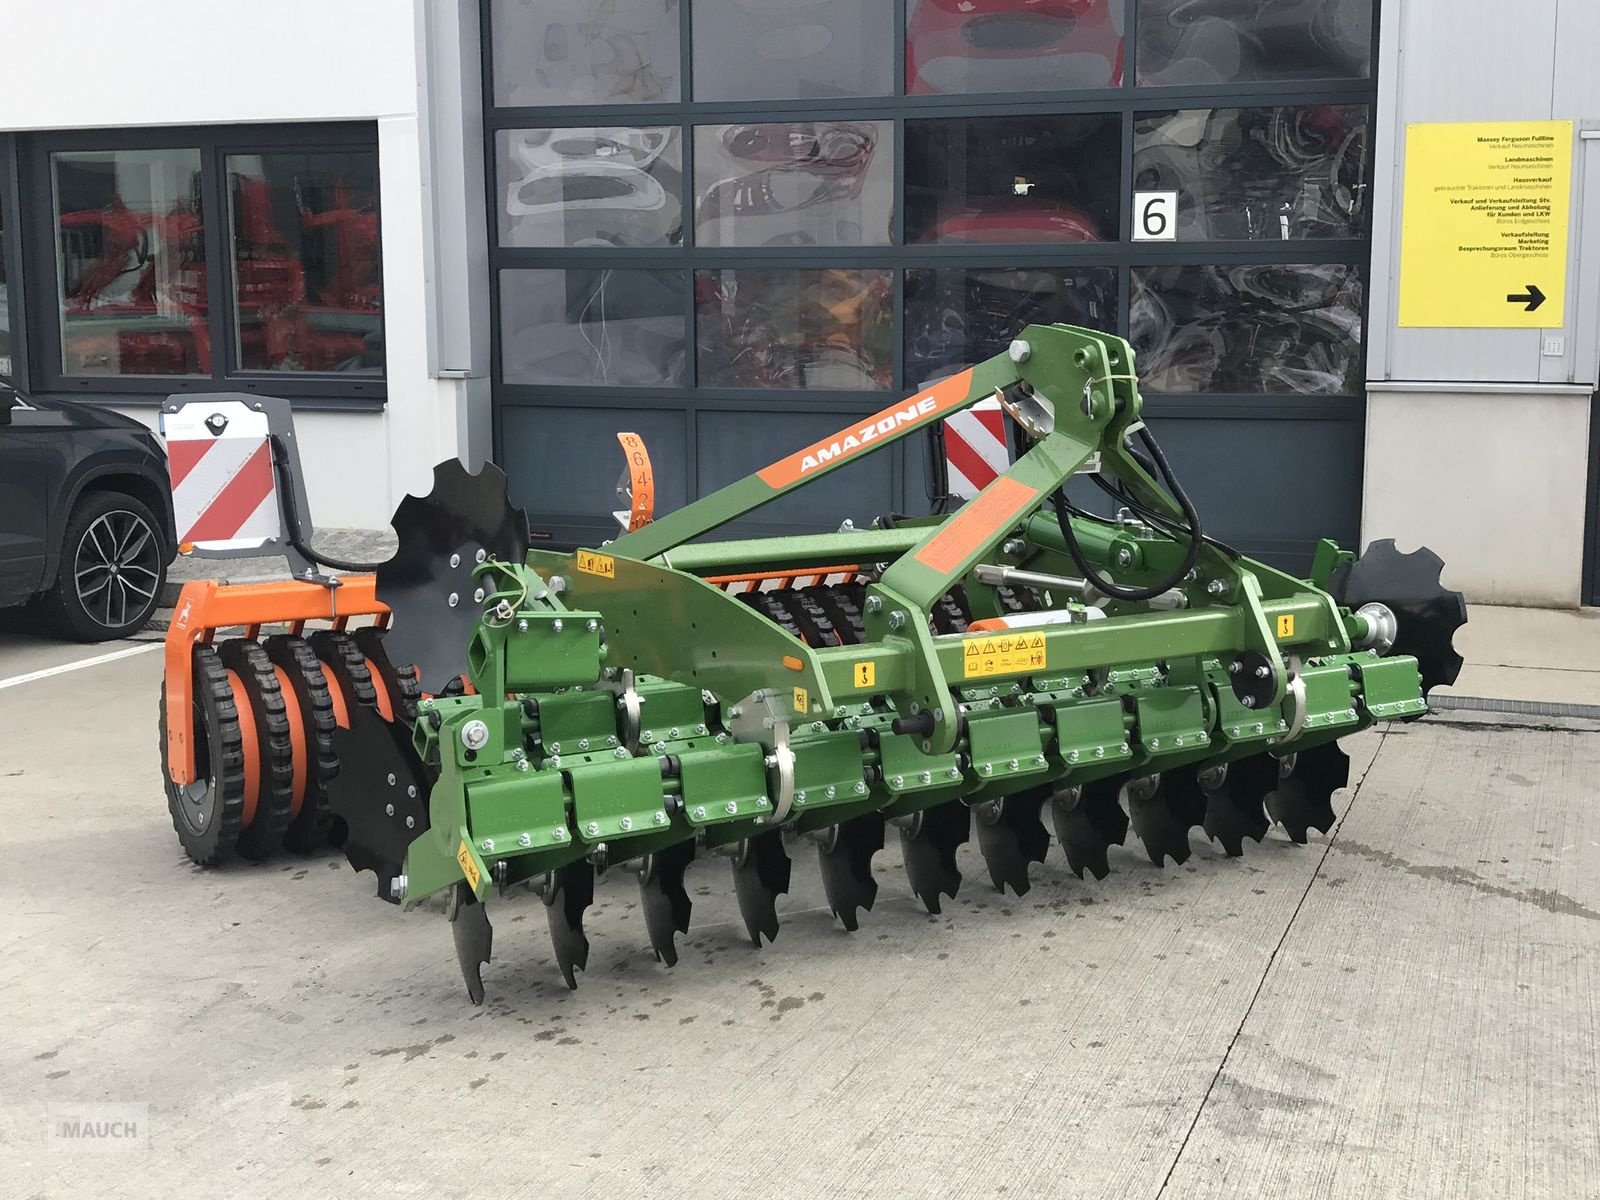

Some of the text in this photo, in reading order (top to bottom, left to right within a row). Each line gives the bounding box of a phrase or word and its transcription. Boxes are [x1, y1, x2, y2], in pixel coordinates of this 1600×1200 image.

[1143, 198, 1166, 236] 6
[800, 396, 937, 472] AMAZONE
[626, 436, 638, 448] 8
[633, 452, 644, 466] 6
[638, 472, 648, 486] 4
[638, 493, 648, 510] 2
